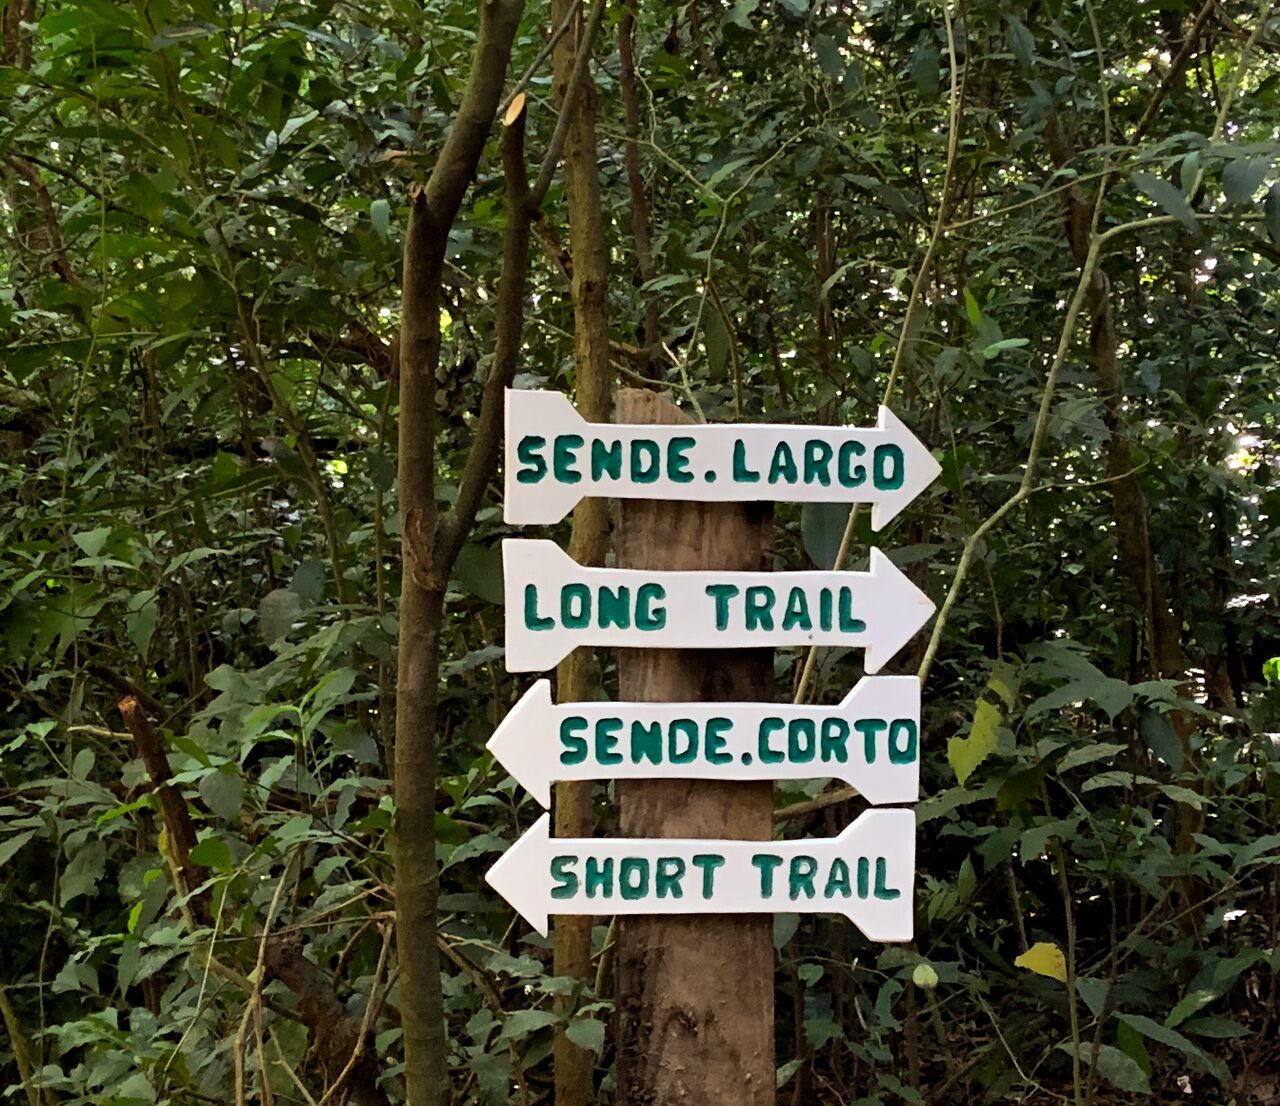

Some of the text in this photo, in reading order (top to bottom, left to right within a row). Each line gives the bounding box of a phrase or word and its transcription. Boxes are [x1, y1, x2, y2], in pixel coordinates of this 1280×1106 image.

[732, 439, 906, 491] LARGO
[523, 582, 868, 634] LONG TRAIL
[549, 853, 902, 901] SHORT TRAIL
